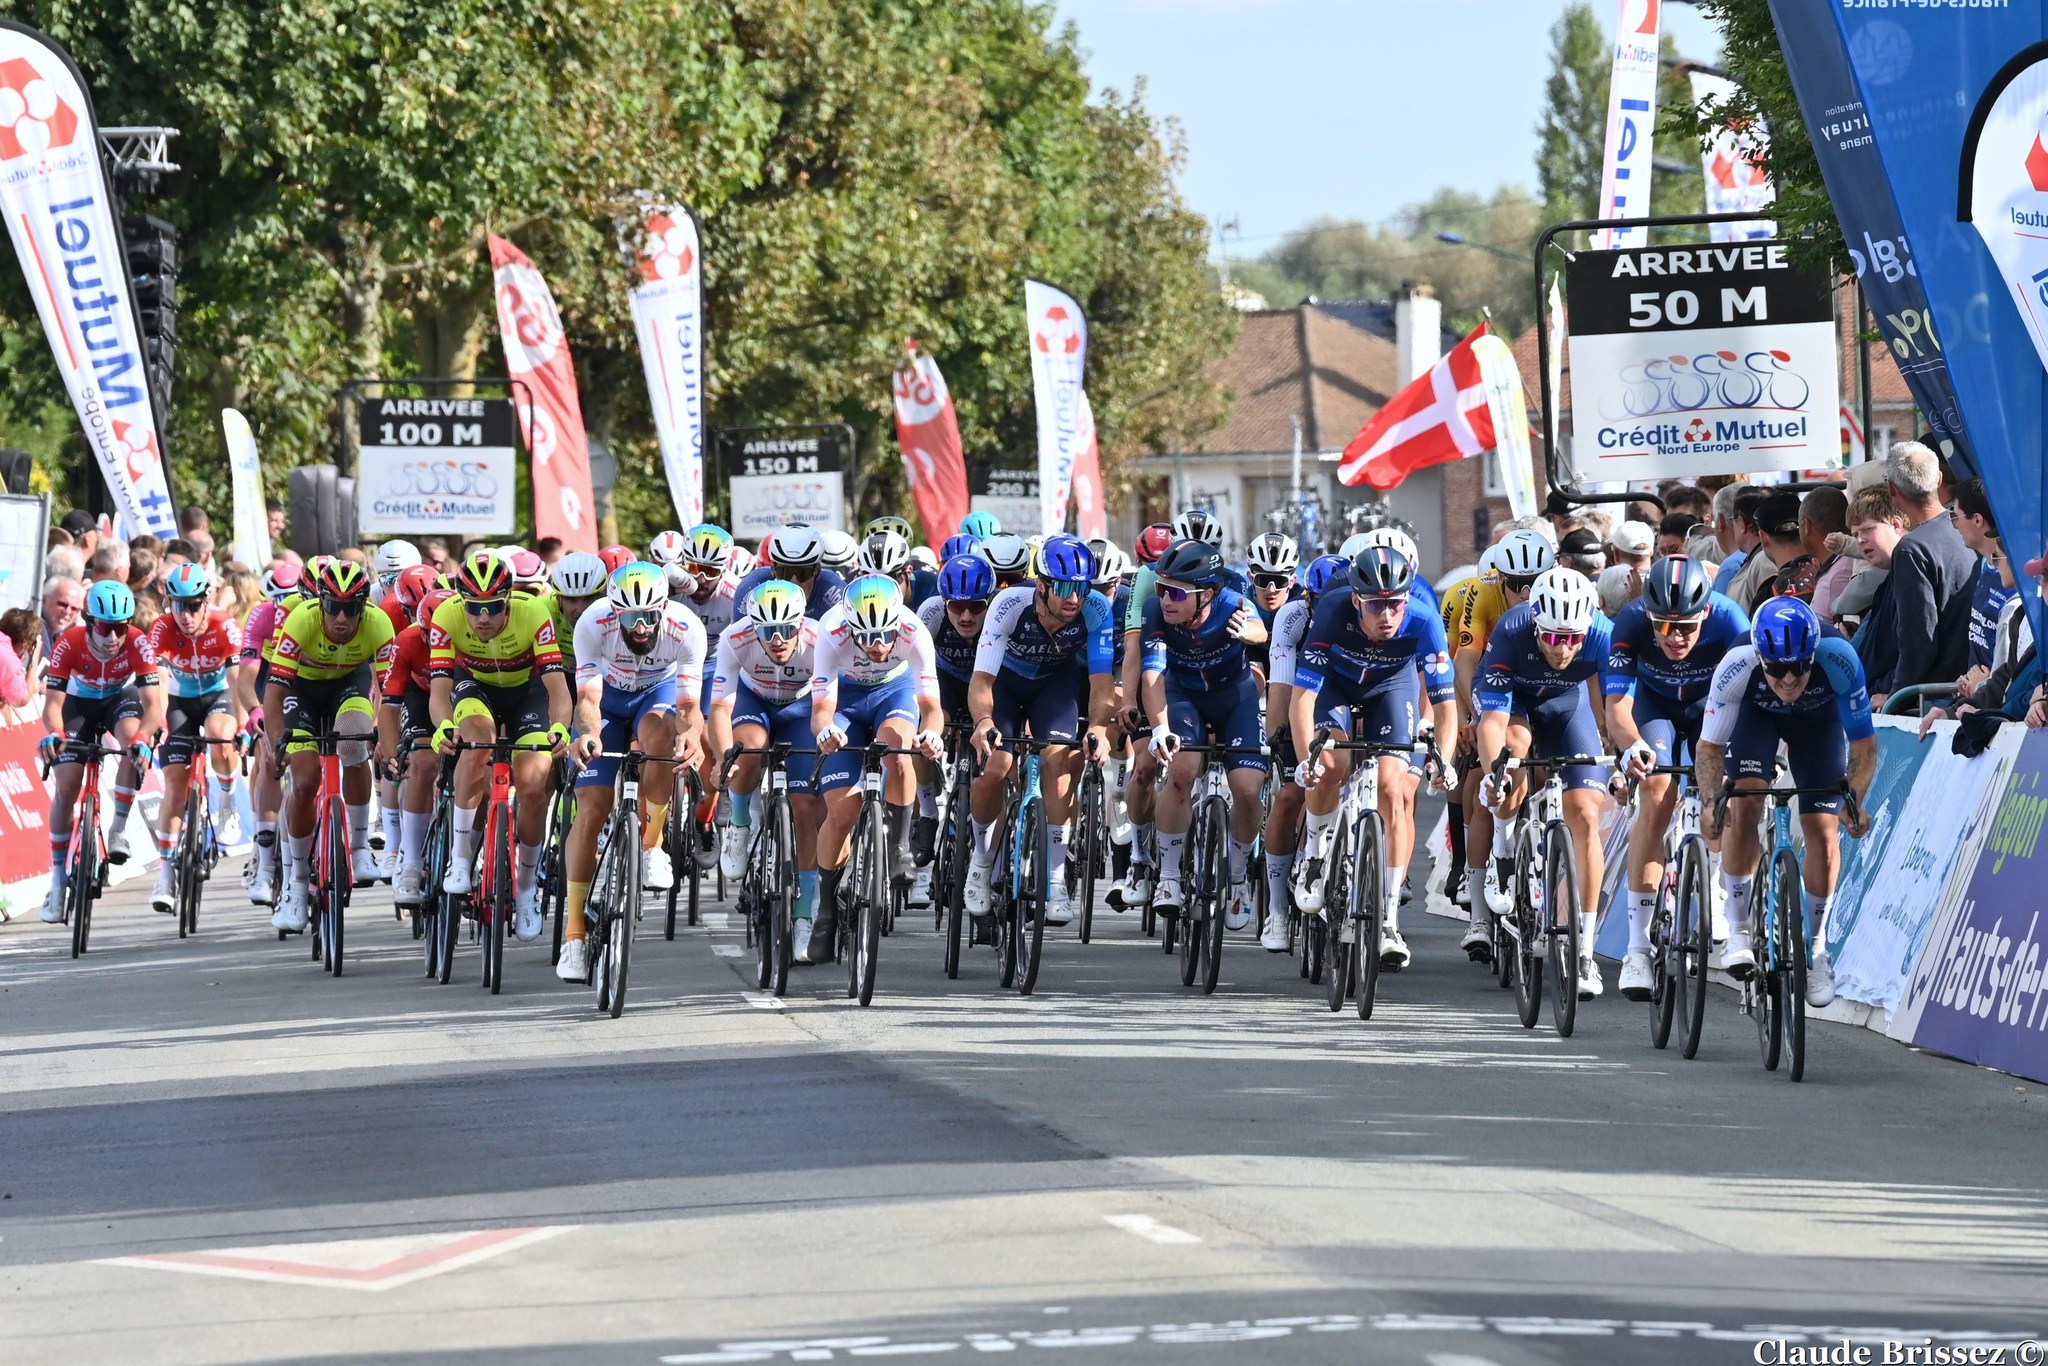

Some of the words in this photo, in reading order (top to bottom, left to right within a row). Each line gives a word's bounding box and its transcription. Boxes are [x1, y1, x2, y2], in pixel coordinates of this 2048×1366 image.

[1611, 245, 1789, 278] ARRIVEE
[1629, 290, 1700, 328] 50
[1720, 286, 1768, 322] M
[380, 399, 485, 417] ARRIVEE
[379, 422, 443, 446] 100
[452, 423, 482, 446] M
[1597, 425, 1680, 448] Crédit
[1715, 416, 1807, 441] Mutuel
[743, 438, 819, 454] ARRIVEE
[1657, 443, 1689, 456] Nord
[1692, 442, 1740, 454] Europe
[743, 457, 790, 475] 150
[796, 456, 819, 472] M
[986, 482, 1025, 497] 200
[373, 499, 421, 516] Crédit
[442, 501, 496, 516] Mutuel
[994, 595, 1021, 623] FANTINI
[1464, 584, 1479, 628] MAVIC
[246, 606, 263, 631] RYSEL
[50, 638, 72, 669] dstny
[279, 638, 302, 658] B!
[172, 654, 221, 669] lotto
[1716, 658, 1748, 692] FANTINI
[1030, 757, 1039, 794] FACTOR
[1739, 766, 1763, 774] CHANGE
[1985, 771, 2048, 876] Région
